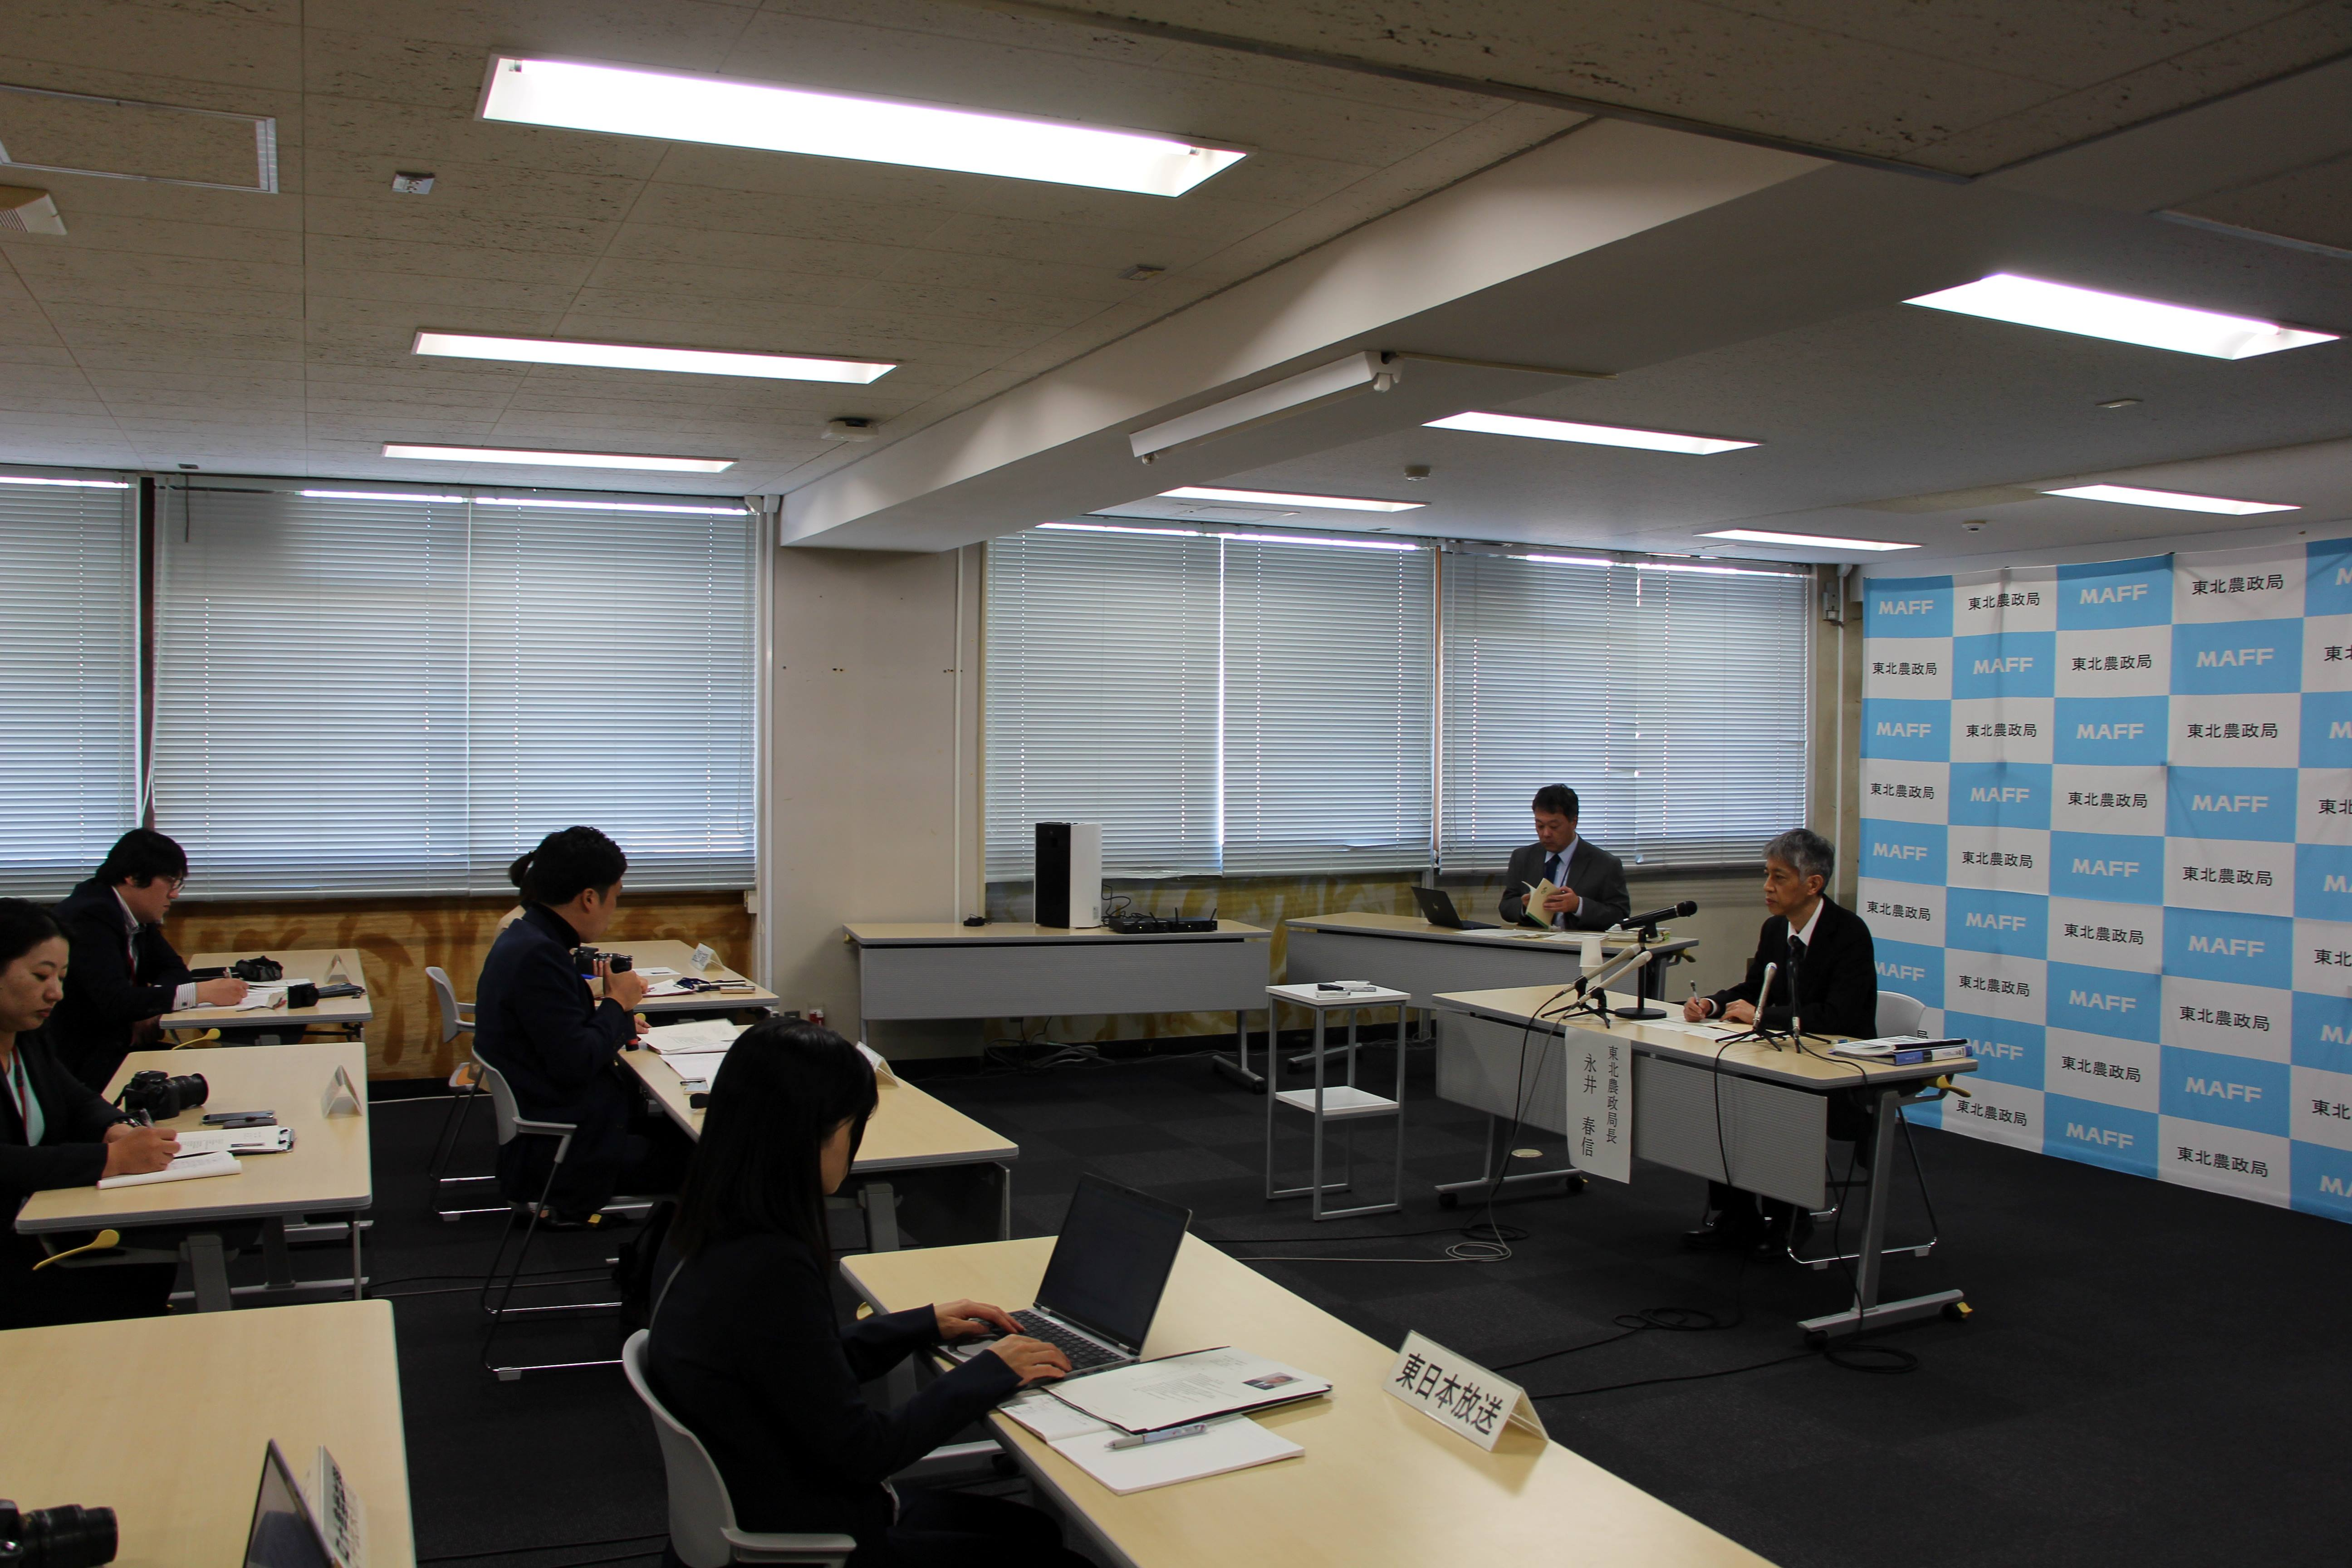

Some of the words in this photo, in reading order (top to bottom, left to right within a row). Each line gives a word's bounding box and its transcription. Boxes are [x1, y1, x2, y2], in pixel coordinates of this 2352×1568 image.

[2080, 583, 2149, 604] MAFF
[2192, 574, 2283, 595] 東北農政局
[1879, 600, 1934, 615] MAFF
[1969, 592, 2039, 610] 東北農政局
[1974, 657, 2034, 674] MAFF
[2072, 654, 2151, 671] 東北農政局
[2197, 648, 2275, 667] MAFF
[1872, 662, 1936, 676] 東北農政局
[1877, 722, 1932, 738] MAFF
[1966, 723, 2036, 737] 東北農政局
[2077, 723, 2145, 740] MAFF
[2187, 723, 2278, 739] 東北農政局
[1871, 783, 1934, 799] 東北農政局
[1971, 787, 2030, 803] MAFF
[2068, 792, 2147, 808] 東北農政局
[2192, 795, 2269, 813] MAFF
[1873, 842, 1928, 860] MAFF
[1962, 851, 2032, 868] 東北農政局
[2073, 858, 2140, 877] MAFF
[2183, 867, 2272, 887] 東北農政局
[1866, 901, 1931, 921] 東北農政局
[1966, 912, 2026, 931] MAFF
[2064, 924, 2143, 945] 東北農政局
[2189, 936, 2265, 957] MAFF
[1959, 975, 2029, 997] 東北農政局
[2069, 990, 2137, 1012] MAFF
[2180, 1006, 2269, 1031] 東北農政局
[1583, 1053, 1597, 1094] 永井
[2062, 1056, 2141, 1083] 東北農政局
[1606, 1045, 1619, 1144] 東北農政局長
[2186, 1077, 2263, 1102] MAFF
[1956, 1099, 2027, 1127] 東北農政局
[1581, 1116, 1596, 1157] 春信
[2067, 1123, 2134, 1149] MAFF
[2177, 1147, 2268, 1177] 東北農政局
[1396, 1352, 1503, 1436] 東日本放送
